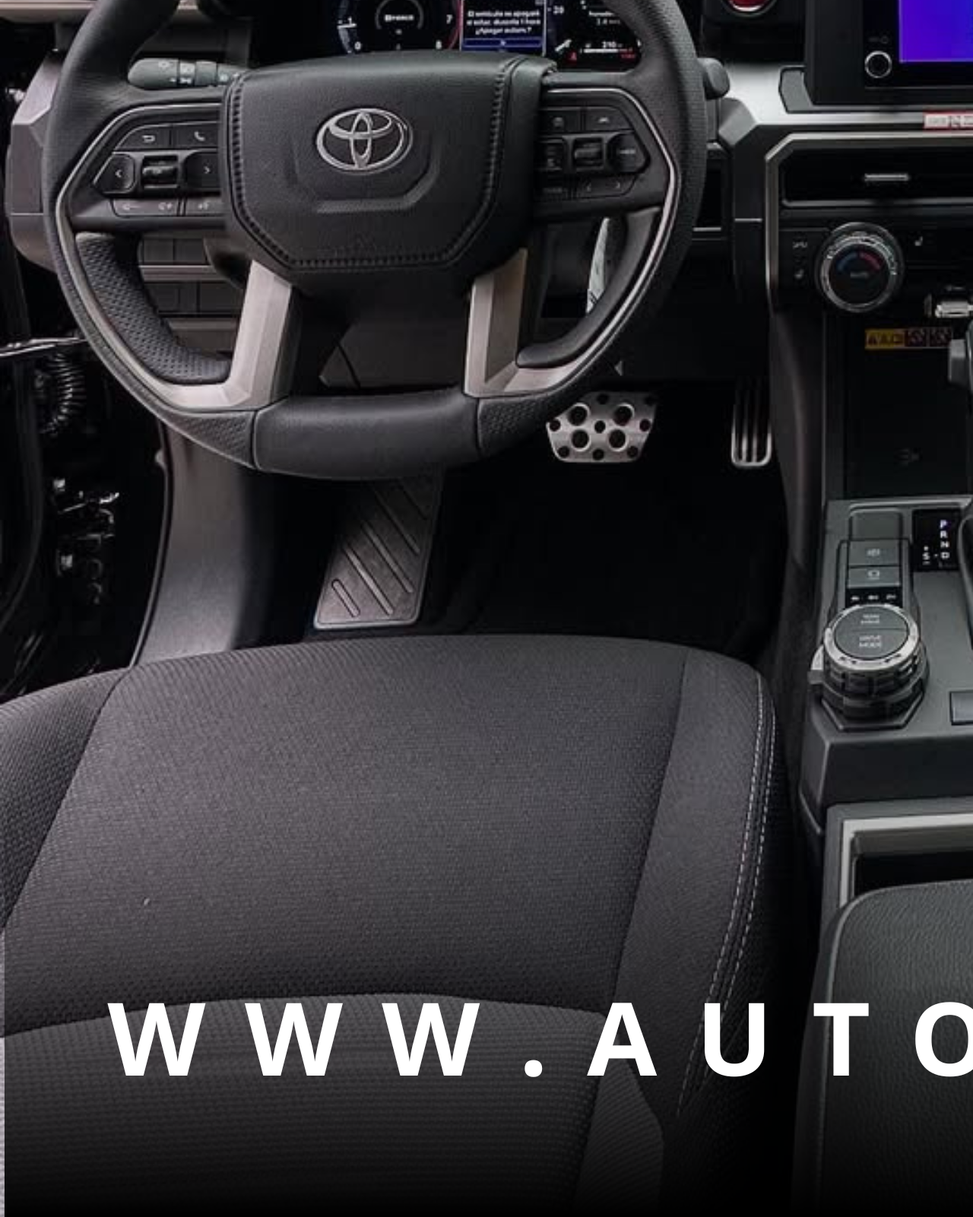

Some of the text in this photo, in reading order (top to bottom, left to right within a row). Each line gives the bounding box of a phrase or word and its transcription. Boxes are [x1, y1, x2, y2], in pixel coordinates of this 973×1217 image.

[939, 519, 948, 529] P
[939, 530, 948, 539] R
[940, 551, 950, 559] D
